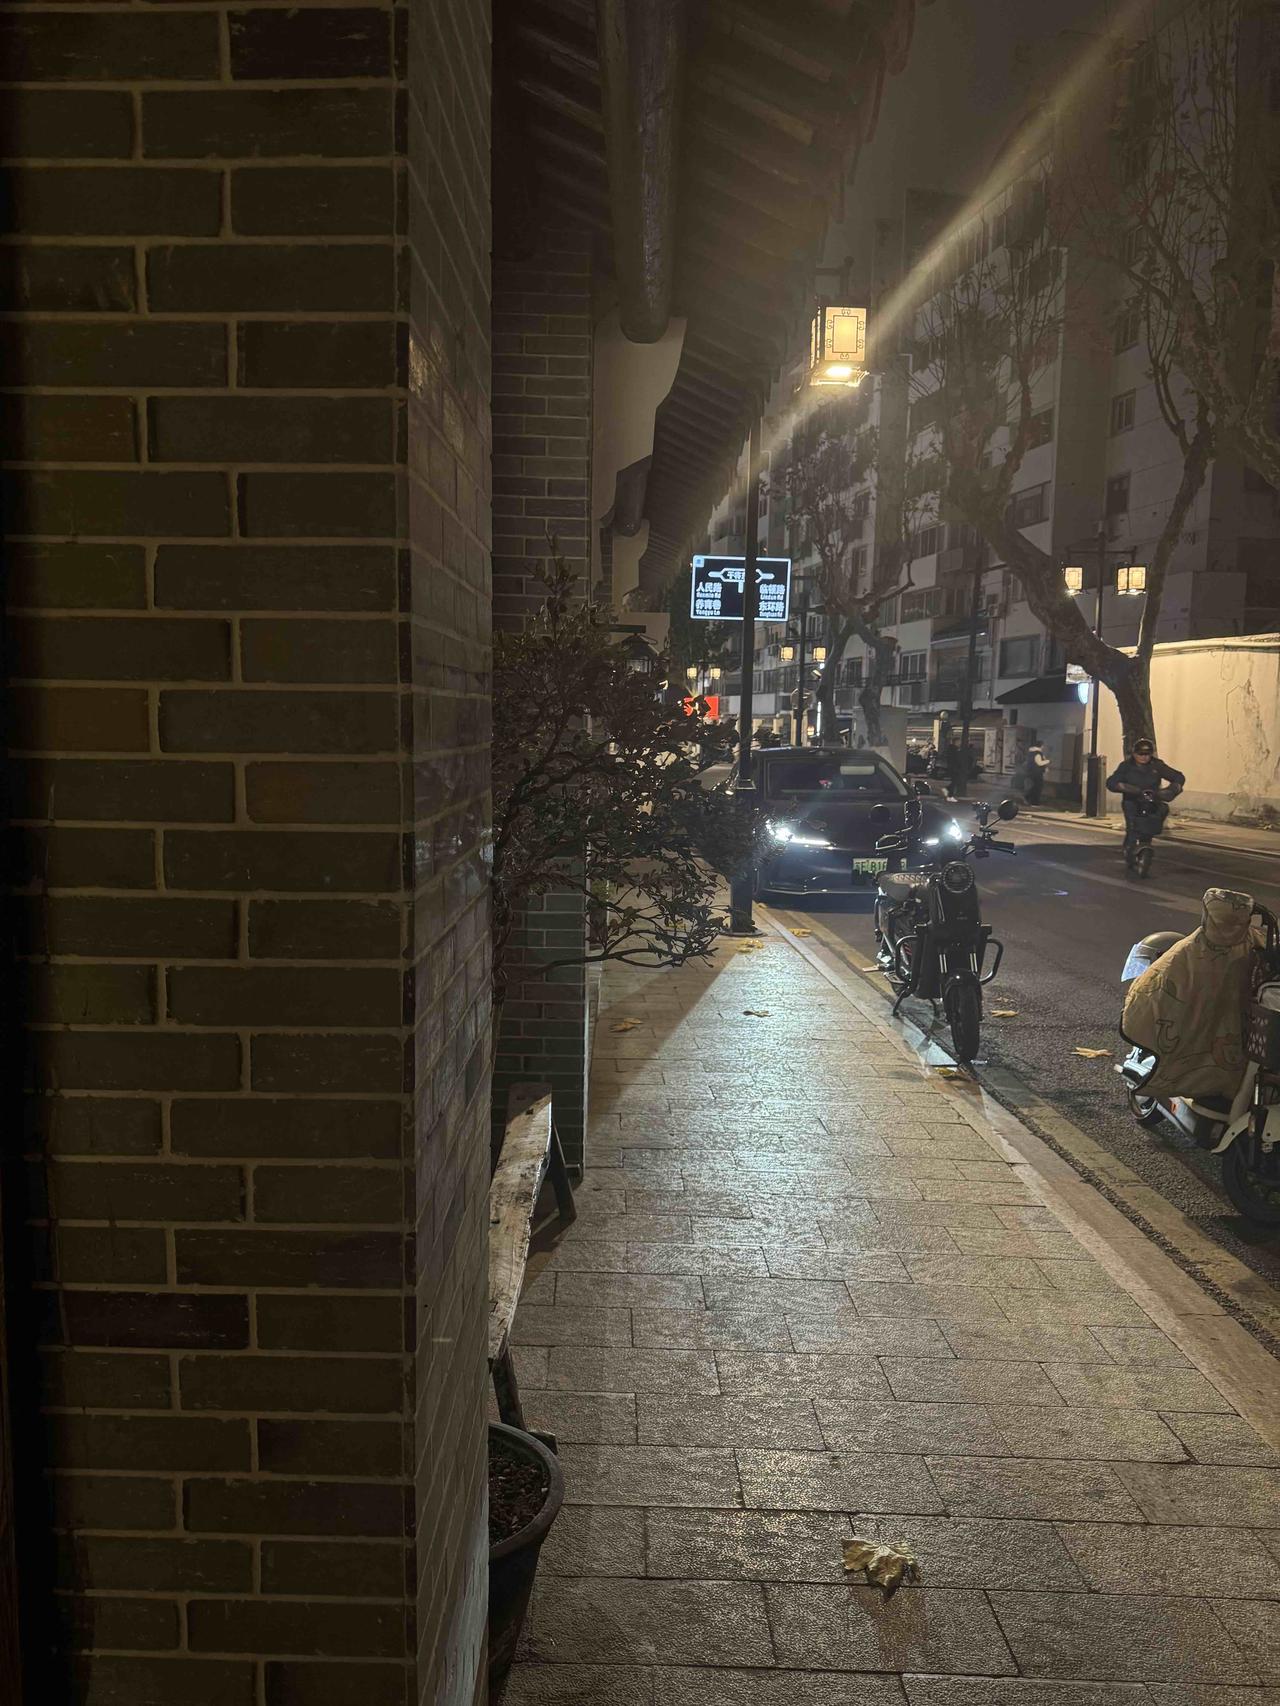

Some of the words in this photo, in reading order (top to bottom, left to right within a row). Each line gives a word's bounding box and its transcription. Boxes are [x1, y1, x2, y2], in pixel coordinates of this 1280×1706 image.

[696, 581, 722, 593] 人民路
[758, 600, 785, 611] 东环路
